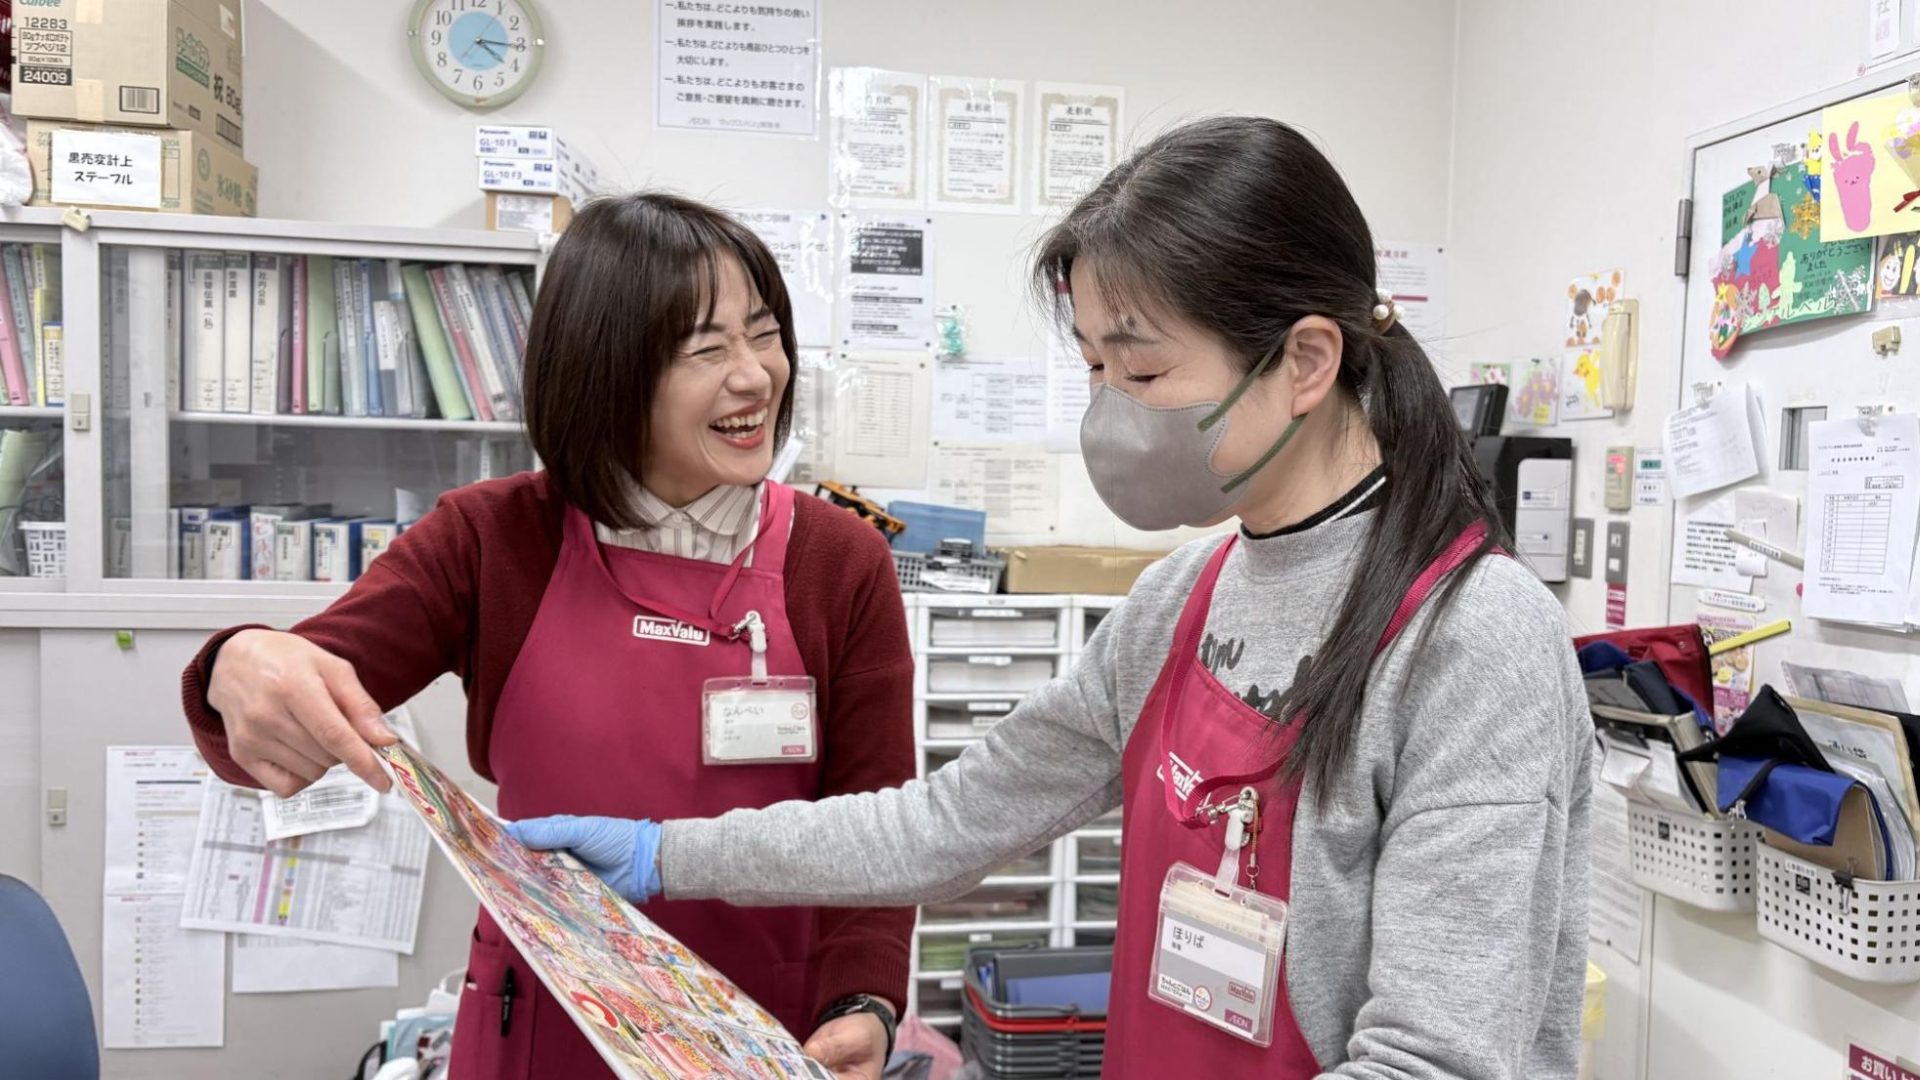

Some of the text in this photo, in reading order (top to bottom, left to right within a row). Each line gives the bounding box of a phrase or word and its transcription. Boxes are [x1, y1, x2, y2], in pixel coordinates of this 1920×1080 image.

[25, 17, 68, 29] 12283
[436, 10, 452, 25] 10
[509, 16, 520, 31] 2
[431, 30, 442, 46] 9
[515, 37, 526, 52] 3
[437, 52, 447, 67] 8
[511, 58, 519, 72] 4
[24, 70, 68, 83] 24009
[454, 69, 463, 84] 7
[473, 75, 483, 90] 6
[494, 72, 504, 87] 5
[68, 151, 133, 168] 黒売変計上
[640, 620, 704, 641] MaxValu
[1173, 925, 1205, 948] ほりば
[1861, 1056, 1914, 1080] お買い
